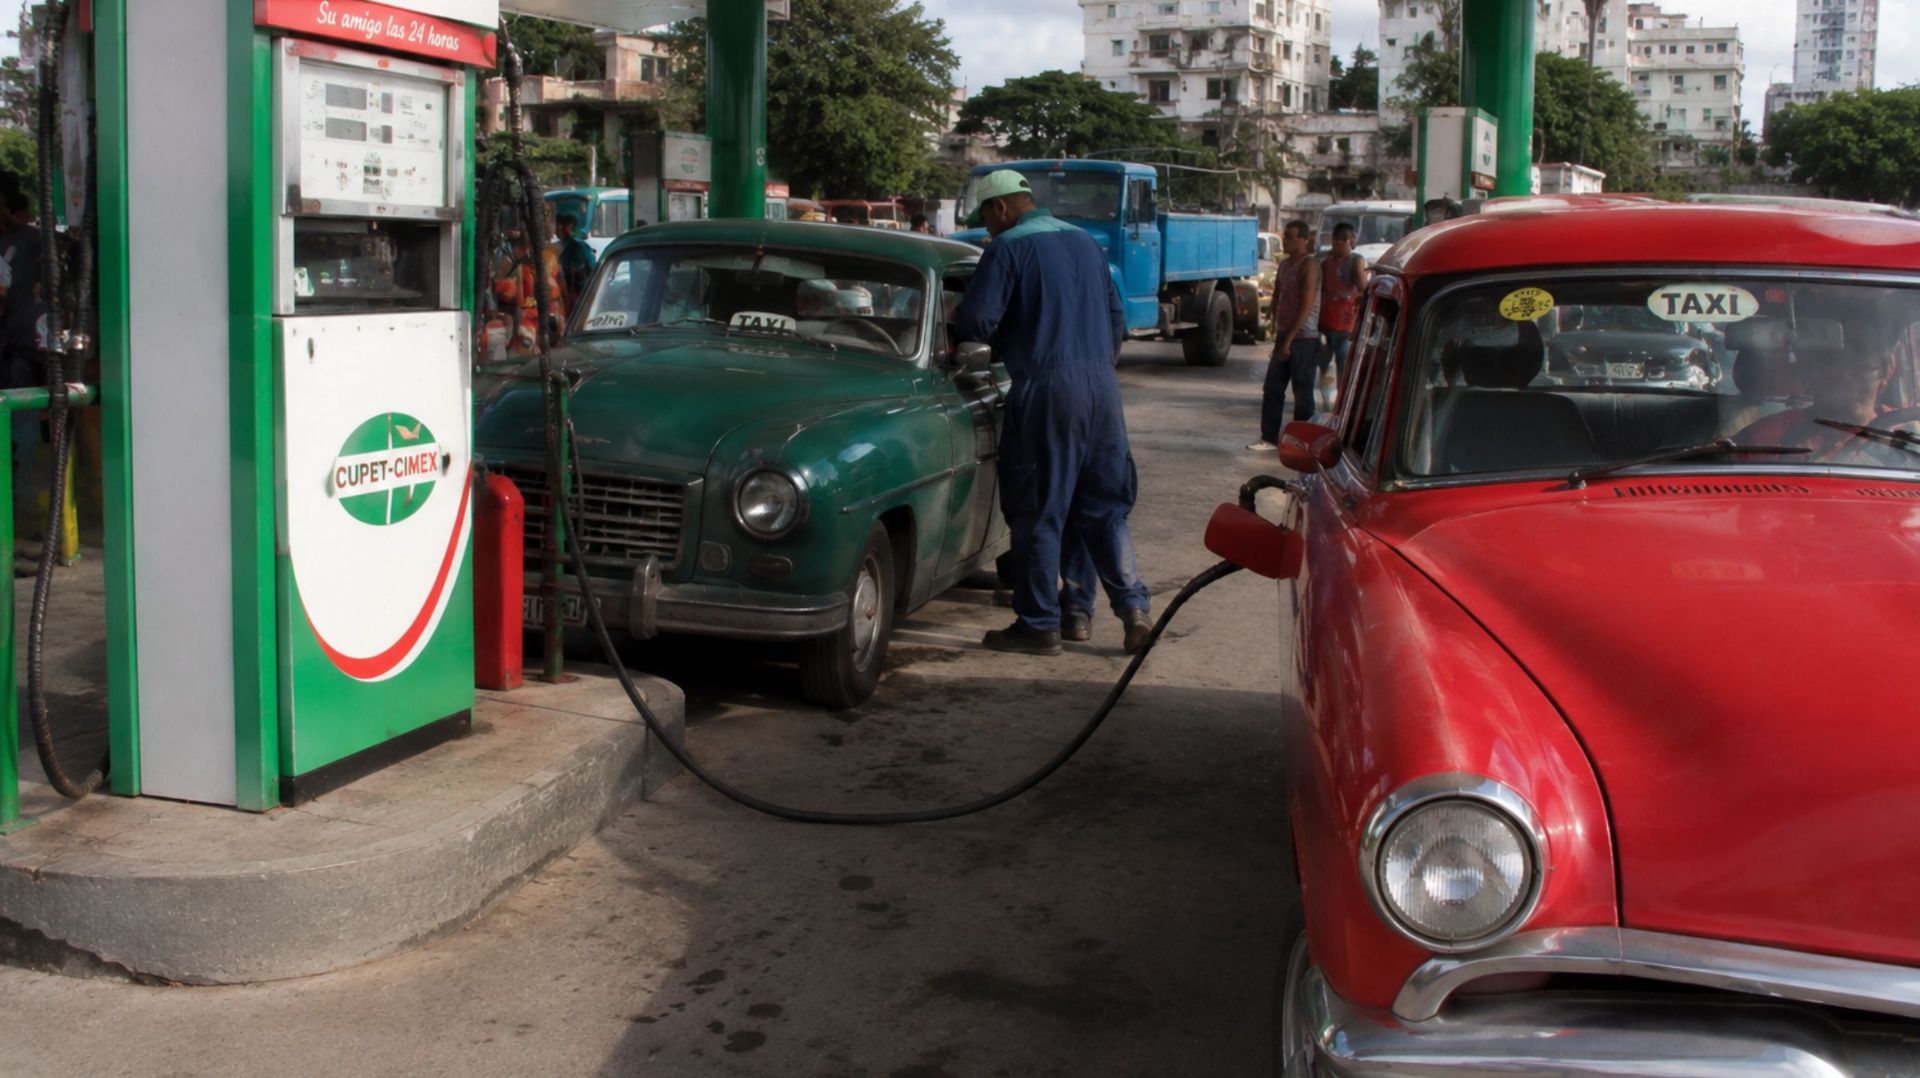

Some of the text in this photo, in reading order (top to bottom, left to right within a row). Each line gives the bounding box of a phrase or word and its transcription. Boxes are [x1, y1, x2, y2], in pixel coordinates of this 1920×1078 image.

[317, 1, 460, 51] Su amigo las 24 horas
[1661, 292, 1741, 316] TAXI
[739, 315, 787, 333] TAXI
[335, 451, 438, 489] CUPET-CIMEX
